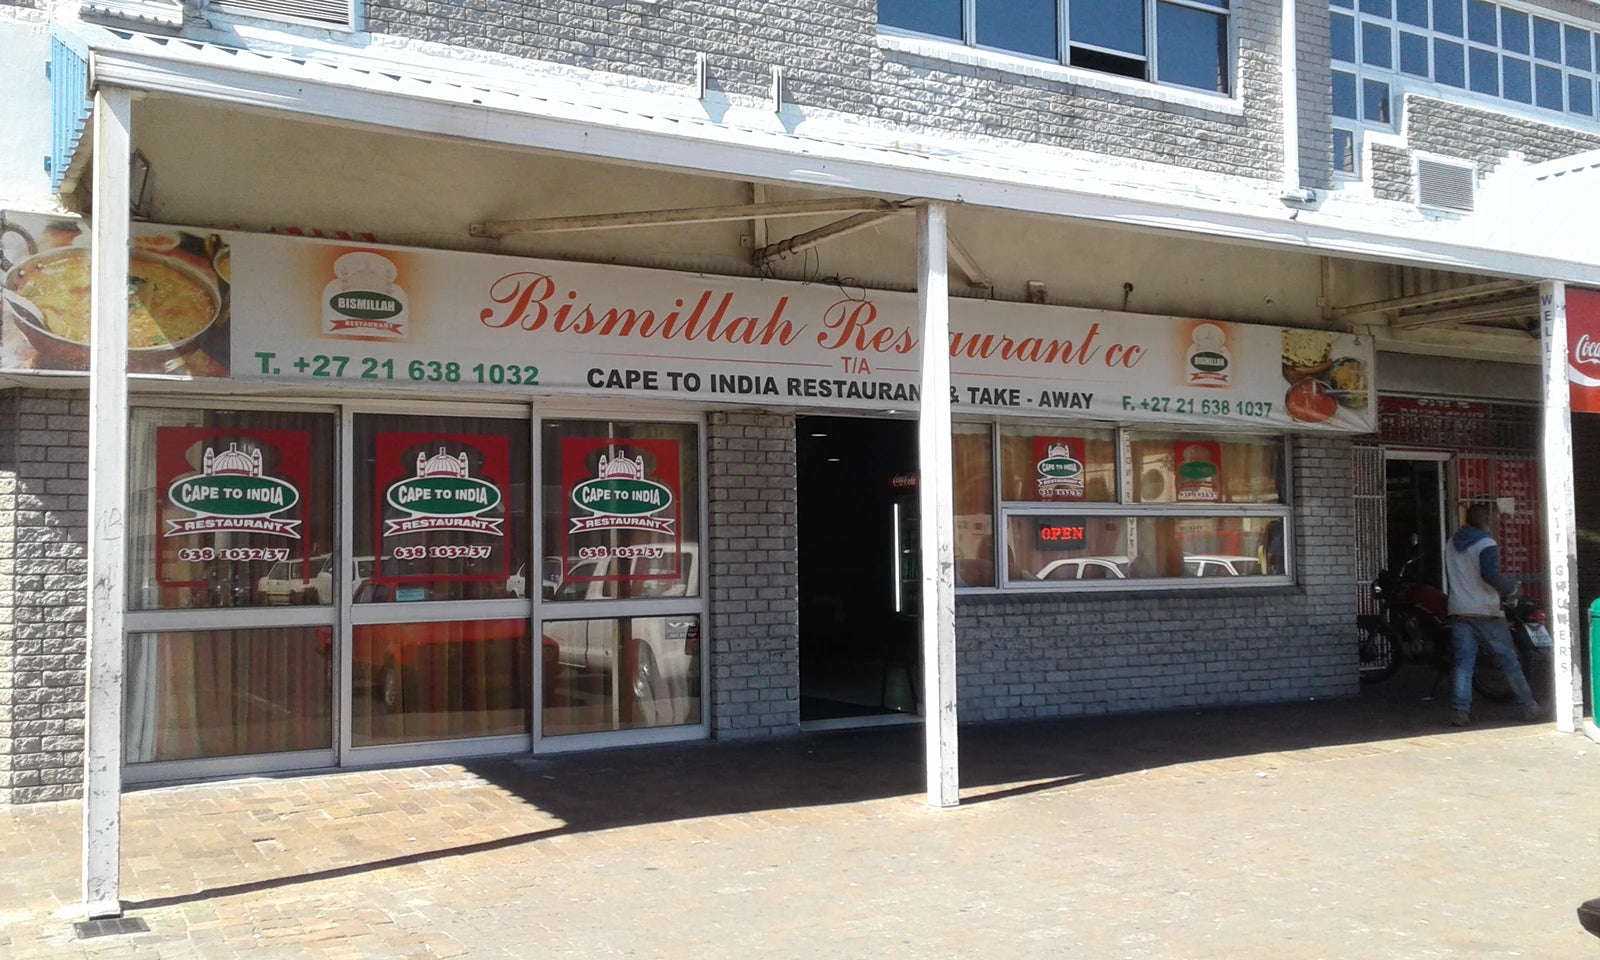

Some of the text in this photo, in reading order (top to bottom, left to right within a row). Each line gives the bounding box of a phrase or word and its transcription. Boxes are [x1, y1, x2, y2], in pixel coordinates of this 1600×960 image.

[337, 297, 396, 312] BISMILLAH
[480, 271, 1149, 368] Bismillah Resaurant cc
[255, 352, 540, 386] T. +27 21 638 1032
[840, 356, 871, 375] T/A
[586, 368, 659, 390] CAPE
[667, 371, 702, 392] TO
[710, 374, 780, 396] INDIA
[787, 378, 921, 402] RESTAURAN
[967, 387, 1021, 406] TAKE
[1038, 391, 1094, 410] AWAY
[1141, 397, 1170, 412] +27
[1176, 398, 1194, 414] 21
[1202, 399, 1230, 415] 638
[1236, 401, 1272, 417] 1037
[182, 483, 284, 506] CAPE TO INDIA
[398, 485, 488, 505] CAPE TO INDIA
[582, 486, 660, 506] CAPE TO INDIA
[184, 519, 283, 531] RESTAURANT
[402, 518, 489, 530] RESTAURANT
[585, 517, 662, 528] RESTAURANT
[1041, 526, 1085, 541] OPEN
[178, 548, 289, 561] 638 1032/37
[394, 545, 491, 560] 638 1032/37
[579, 546, 664, 560] 638 1032/37
